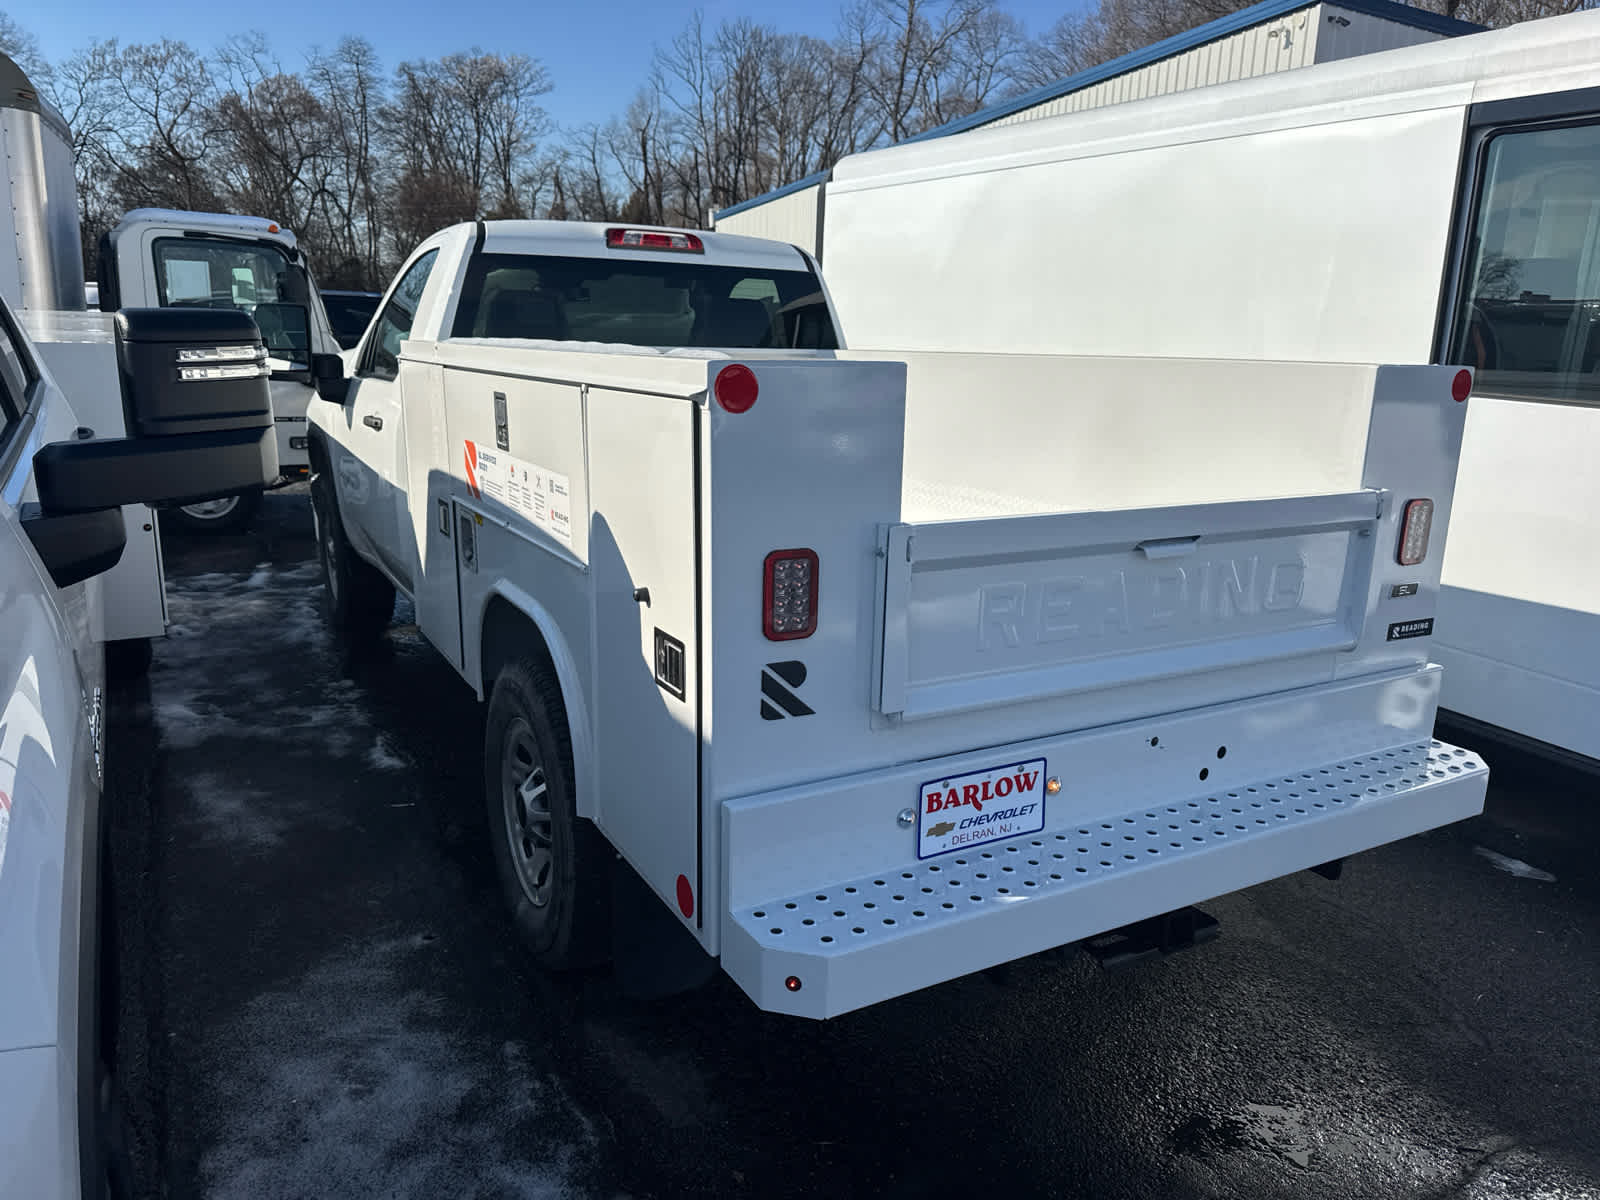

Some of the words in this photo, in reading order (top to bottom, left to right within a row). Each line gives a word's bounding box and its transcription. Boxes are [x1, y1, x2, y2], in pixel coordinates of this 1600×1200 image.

[975, 553, 1305, 652] READING
[1401, 622, 1429, 632] READING
[926, 770, 1039, 814] BARLOW
[959, 802, 1038, 830] CHEVROLET
